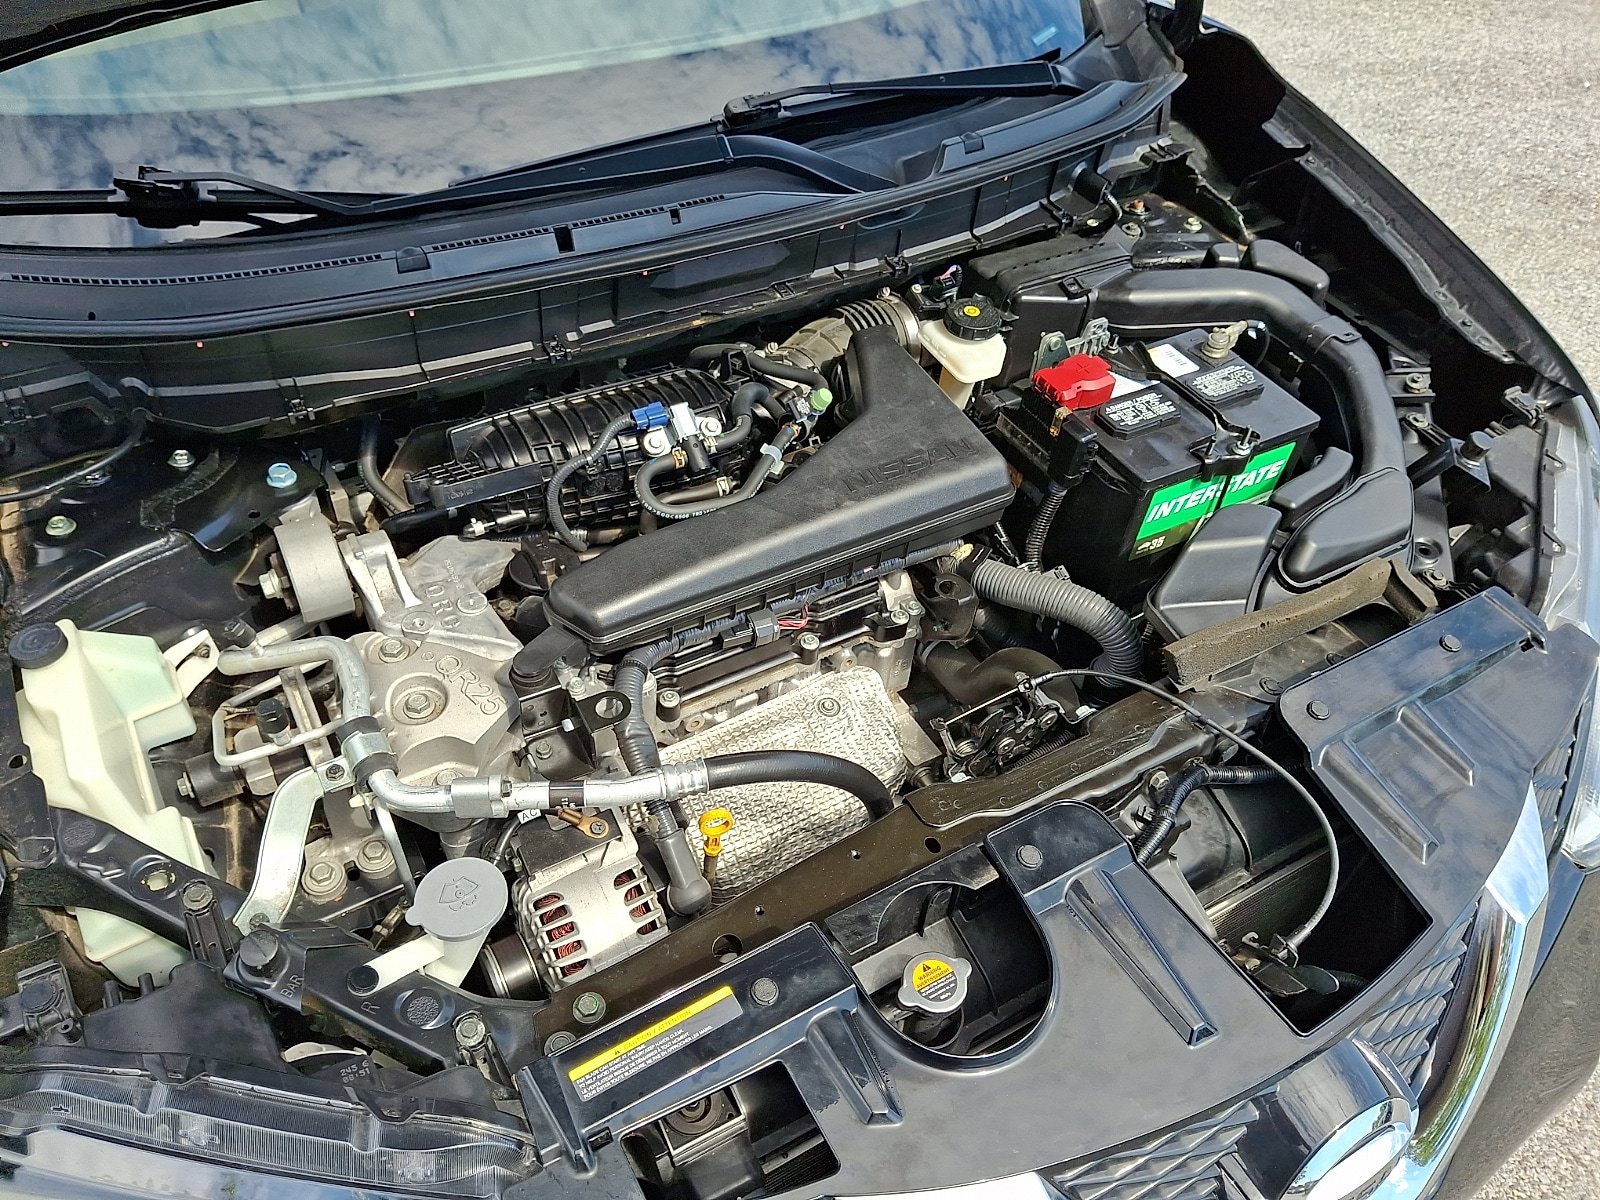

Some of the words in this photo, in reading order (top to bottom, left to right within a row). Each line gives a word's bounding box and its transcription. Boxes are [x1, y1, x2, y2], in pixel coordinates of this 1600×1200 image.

[842, 438, 977, 493] NISSAN
[435, 655, 506, 715] QR25
[280, 975, 304, 998] BAR
[918, 965, 942, 981] WARNING
[622, 1031, 651, 1050] CAUTION
[657, 1009, 691, 1031] ATTENTION
